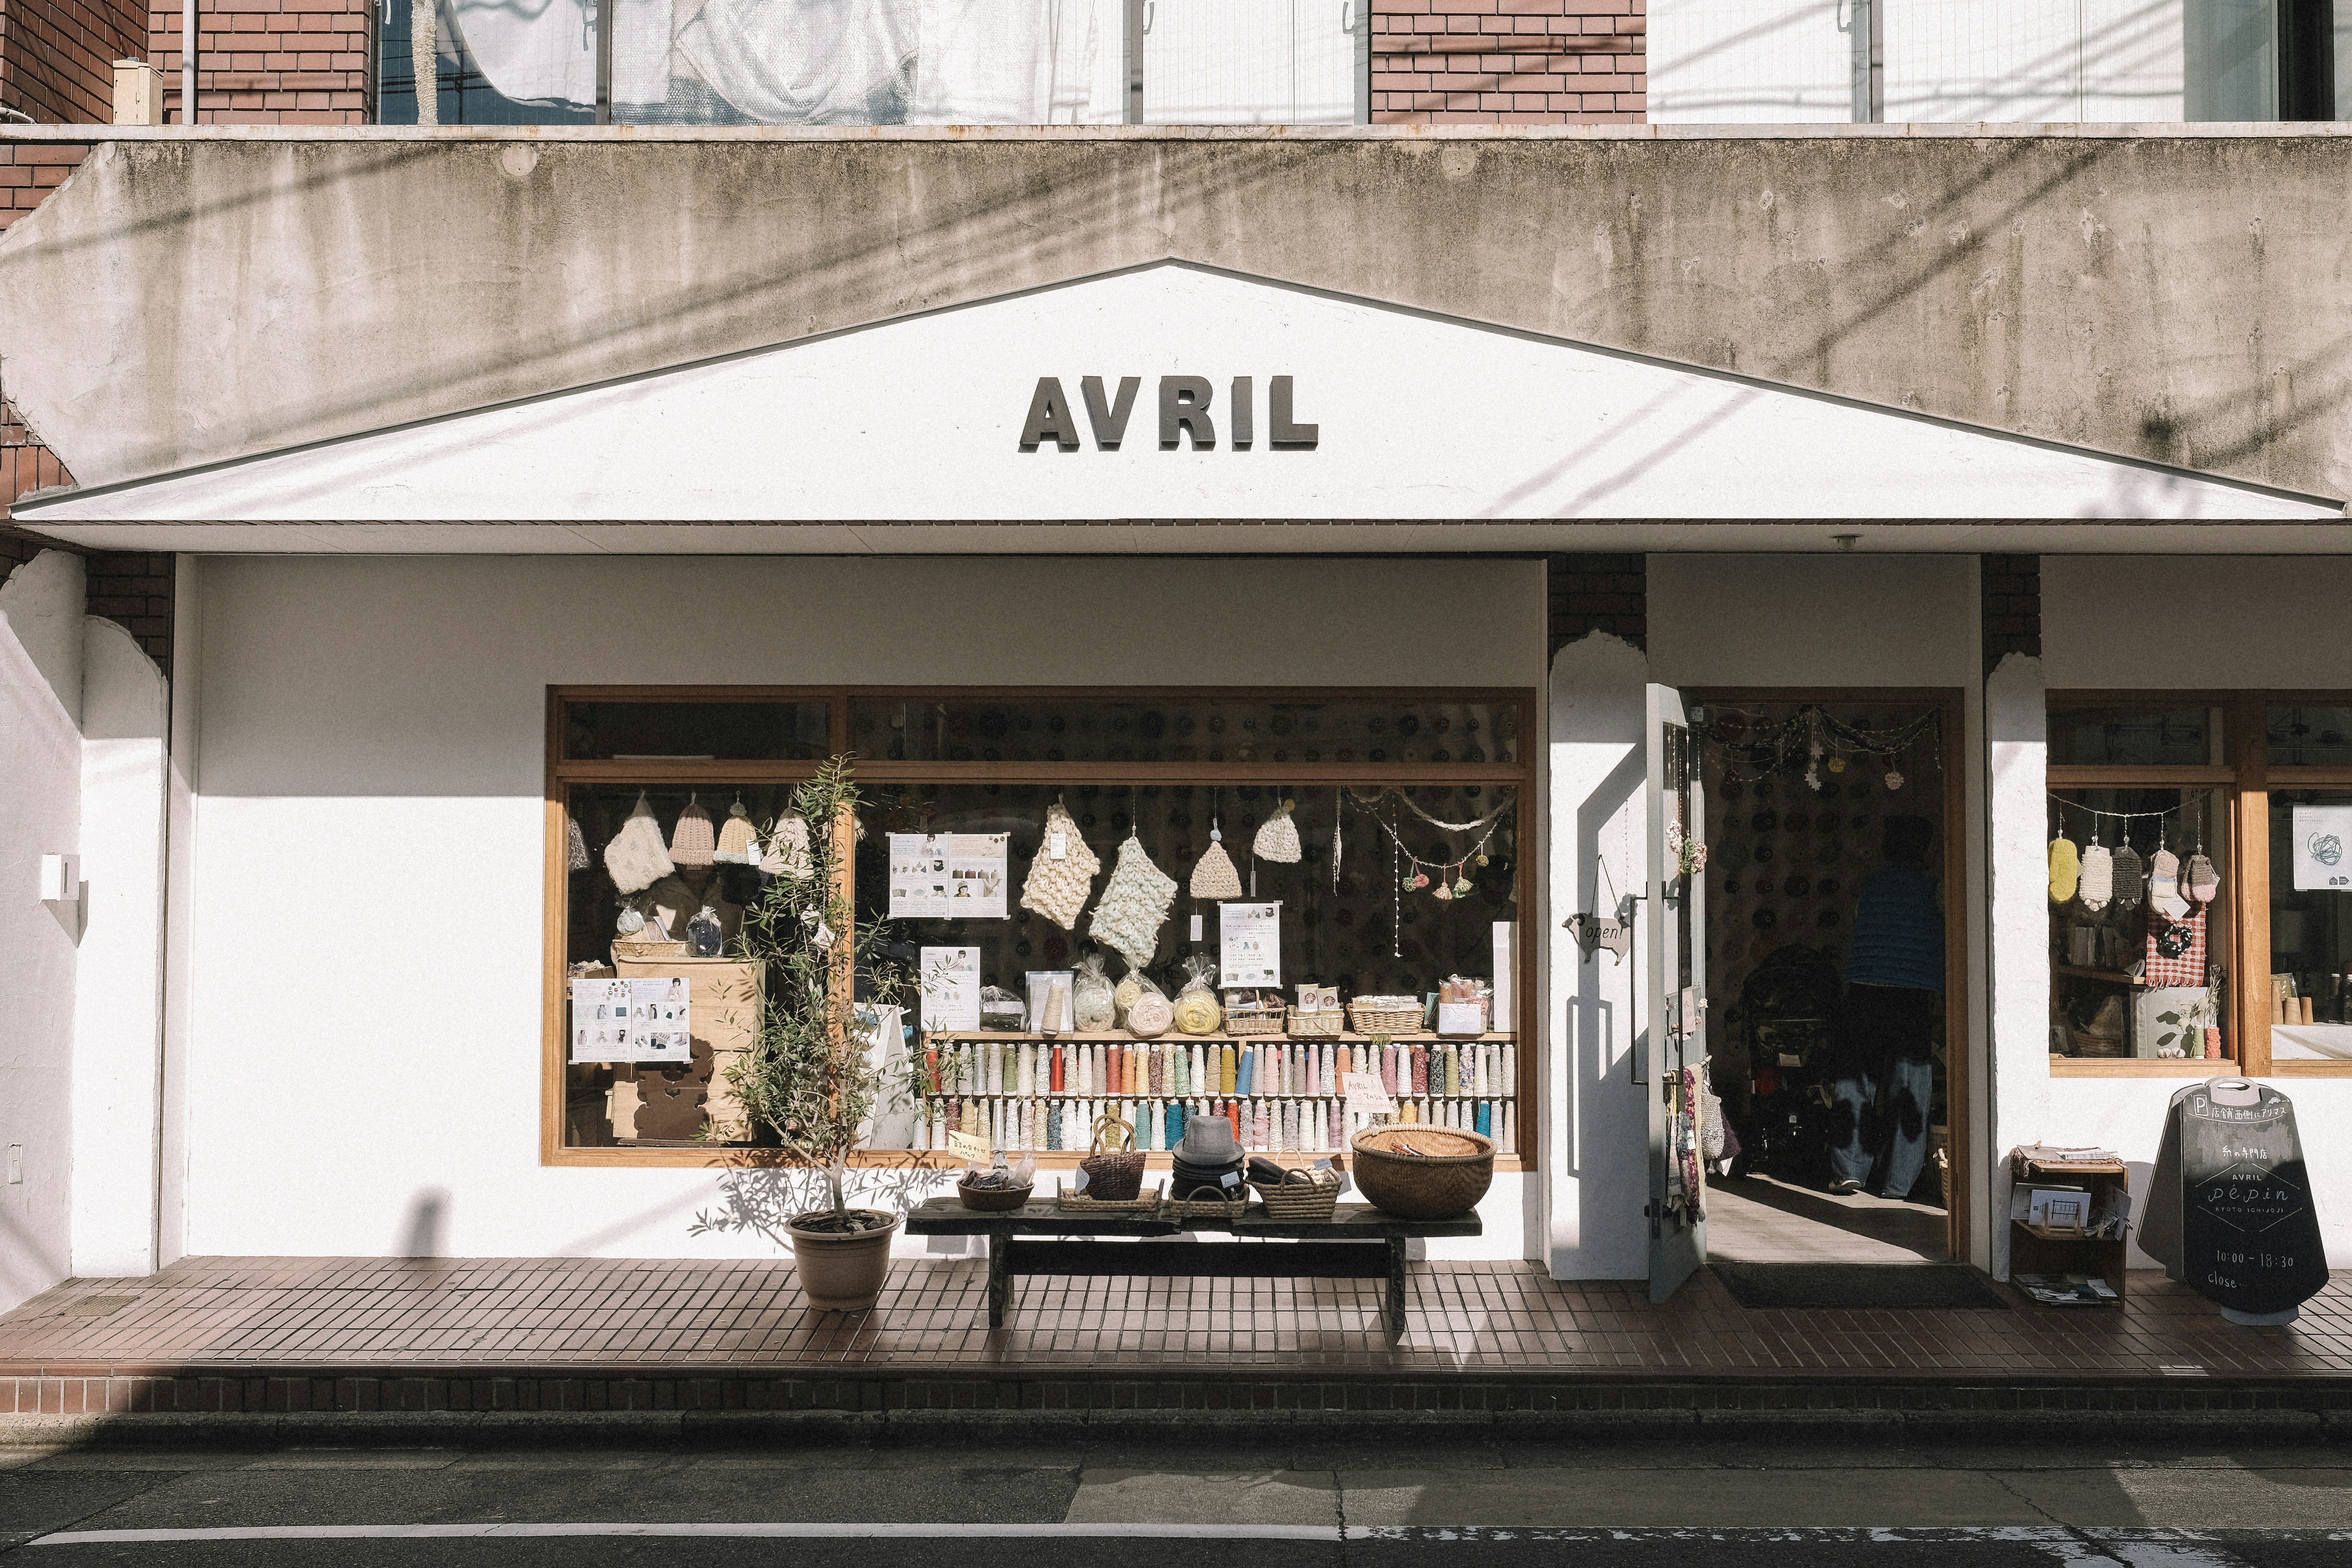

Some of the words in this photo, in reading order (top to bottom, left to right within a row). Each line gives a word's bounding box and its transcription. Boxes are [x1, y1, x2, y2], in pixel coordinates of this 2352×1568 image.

[1018, 376, 1319, 453] AVRIL
[1586, 926, 1623, 943] open!
[1348, 1081, 1368, 1090] AVRIL
[2196, 1097, 2206, 1113] P
[2222, 1145, 2267, 1159] 糸の専門店
[2217, 1250, 2243, 1263] 10:00
[2261, 1253, 2293, 1268] 18:30
